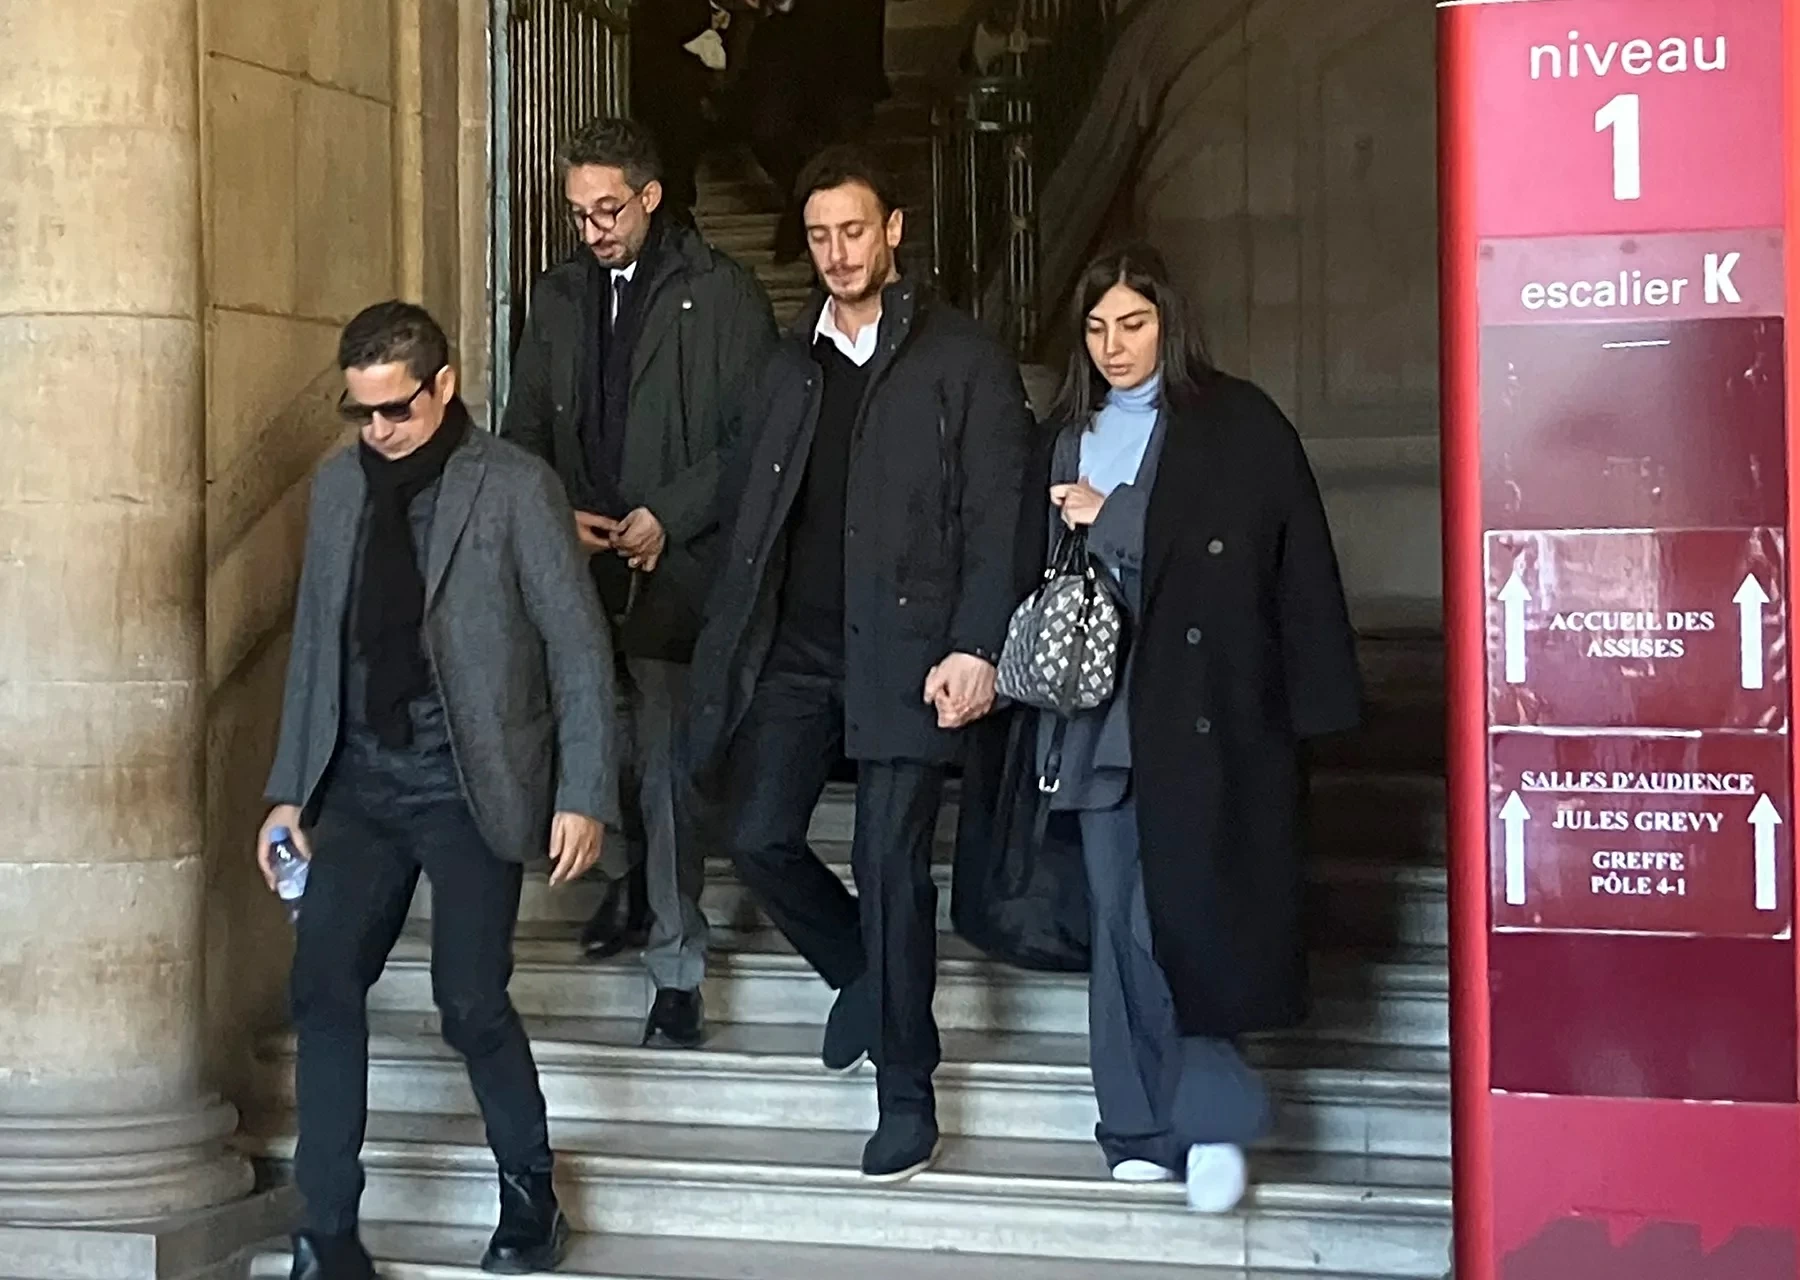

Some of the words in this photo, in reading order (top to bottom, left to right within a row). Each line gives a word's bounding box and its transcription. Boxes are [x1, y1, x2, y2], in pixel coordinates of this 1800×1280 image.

[1530, 30, 1726, 79] niveau
[1594, 93, 1641, 200] 1
[1521, 270, 1688, 310] escalier
[1703, 252, 1741, 304] K
[1549, 611, 1661, 631] ACCUEIL
[1666, 611, 1715, 631] DES
[1586, 638, 1685, 658] ASSISES
[1520, 770, 1607, 790] SALLES
[1612, 772, 1755, 792] D'AUDIENCE
[1552, 809, 1629, 830] JULES
[1634, 811, 1723, 832] GREVY
[1592, 851, 1684, 871] GREFFE
[1591, 871, 1651, 895] PÔLE
[1656, 876, 1686, 896] 4-1
